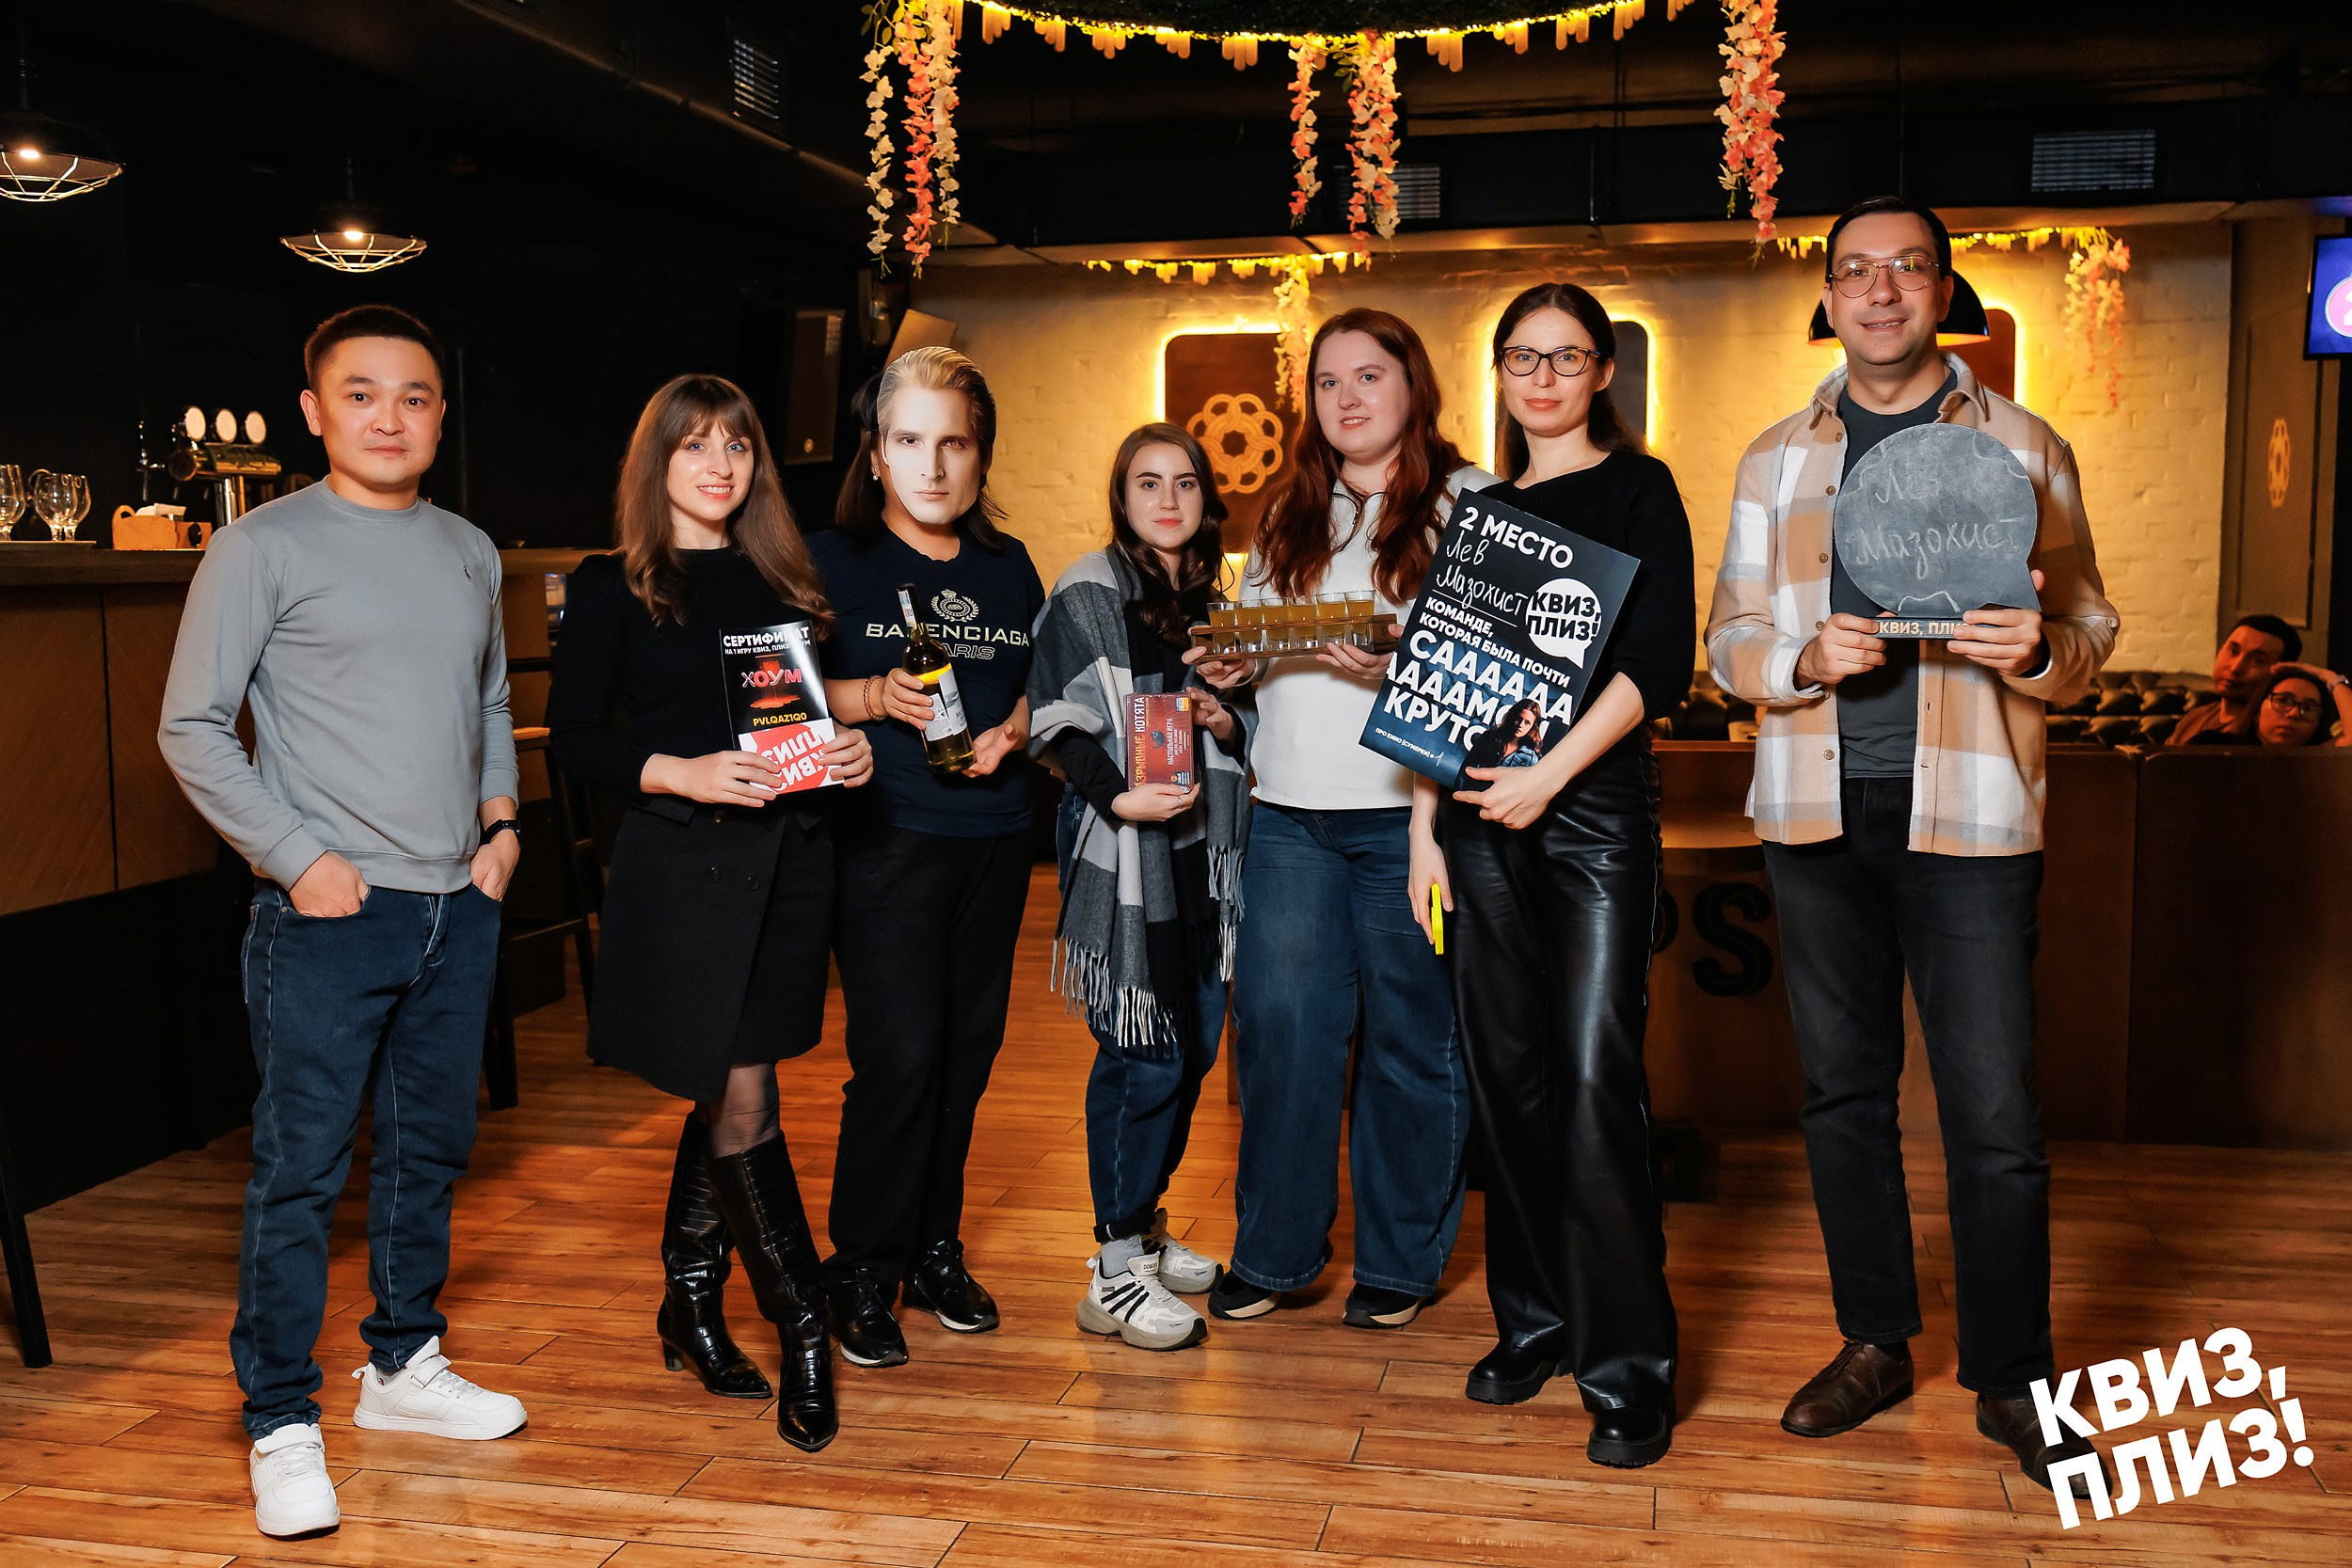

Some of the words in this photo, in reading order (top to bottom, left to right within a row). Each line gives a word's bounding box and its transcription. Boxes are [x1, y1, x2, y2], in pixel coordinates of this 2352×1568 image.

[1446, 529, 1489, 565] Лев
[1459, 506, 1479, 531] 2
[1480, 514, 1574, 569] МЕСТО
[1436, 564, 1529, 616] Мазохист
[1425, 596, 1494, 638] КОМАНДЕ,
[1531, 590, 1601, 625] КВИЗ,
[865, 623, 1030, 647] BAENCIAGA
[1528, 614, 1599, 643] ПЛИЗ!
[1879, 621, 1924, 637] КВИЗ,
[752, 645, 771, 654] КВИЗ,
[942, 642, 995, 659] ARIS
[1419, 611, 1483, 649] КОТОРАЯ
[1481, 641, 1520, 668] БЫЛА
[1521, 657, 1572, 689] ПОЧТИ
[740, 668, 803, 689] ХОУМ
[1134, 696, 1146, 733] КОТЯТА
[1375, 727, 1388, 736] ПРО
[1387, 733, 1402, 744] КИНО
